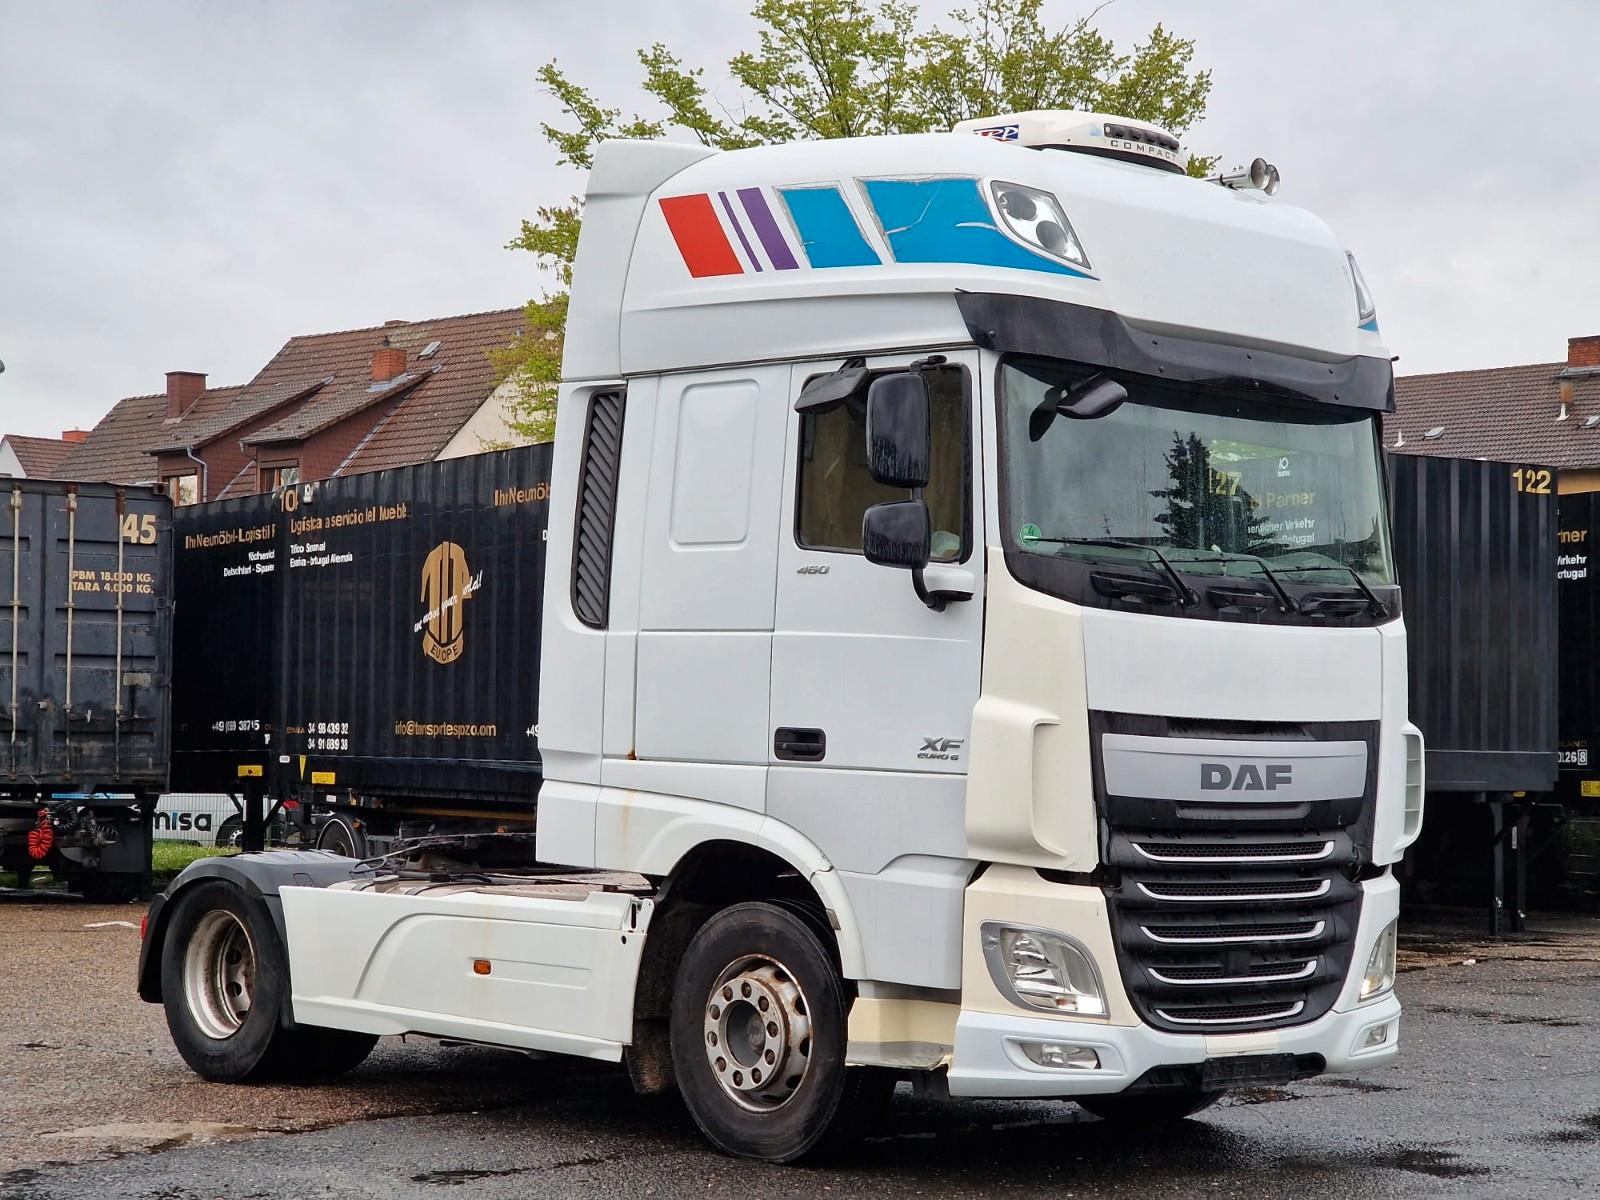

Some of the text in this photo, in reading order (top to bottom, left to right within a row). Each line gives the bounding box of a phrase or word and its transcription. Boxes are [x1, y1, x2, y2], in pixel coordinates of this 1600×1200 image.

[1111, 140, 1176, 160] COMPACT
[1513, 469, 1551, 494] 122
[123, 513, 157, 545] 45
[72, 570, 96, 580] PBM
[136, 573, 154, 583] KG.
[796, 565, 830, 575] 460
[72, 582, 100, 592] TARA
[136, 585, 154, 594] KG.
[919, 736, 965, 751] XF
[1200, 763, 1292, 791] DAF
